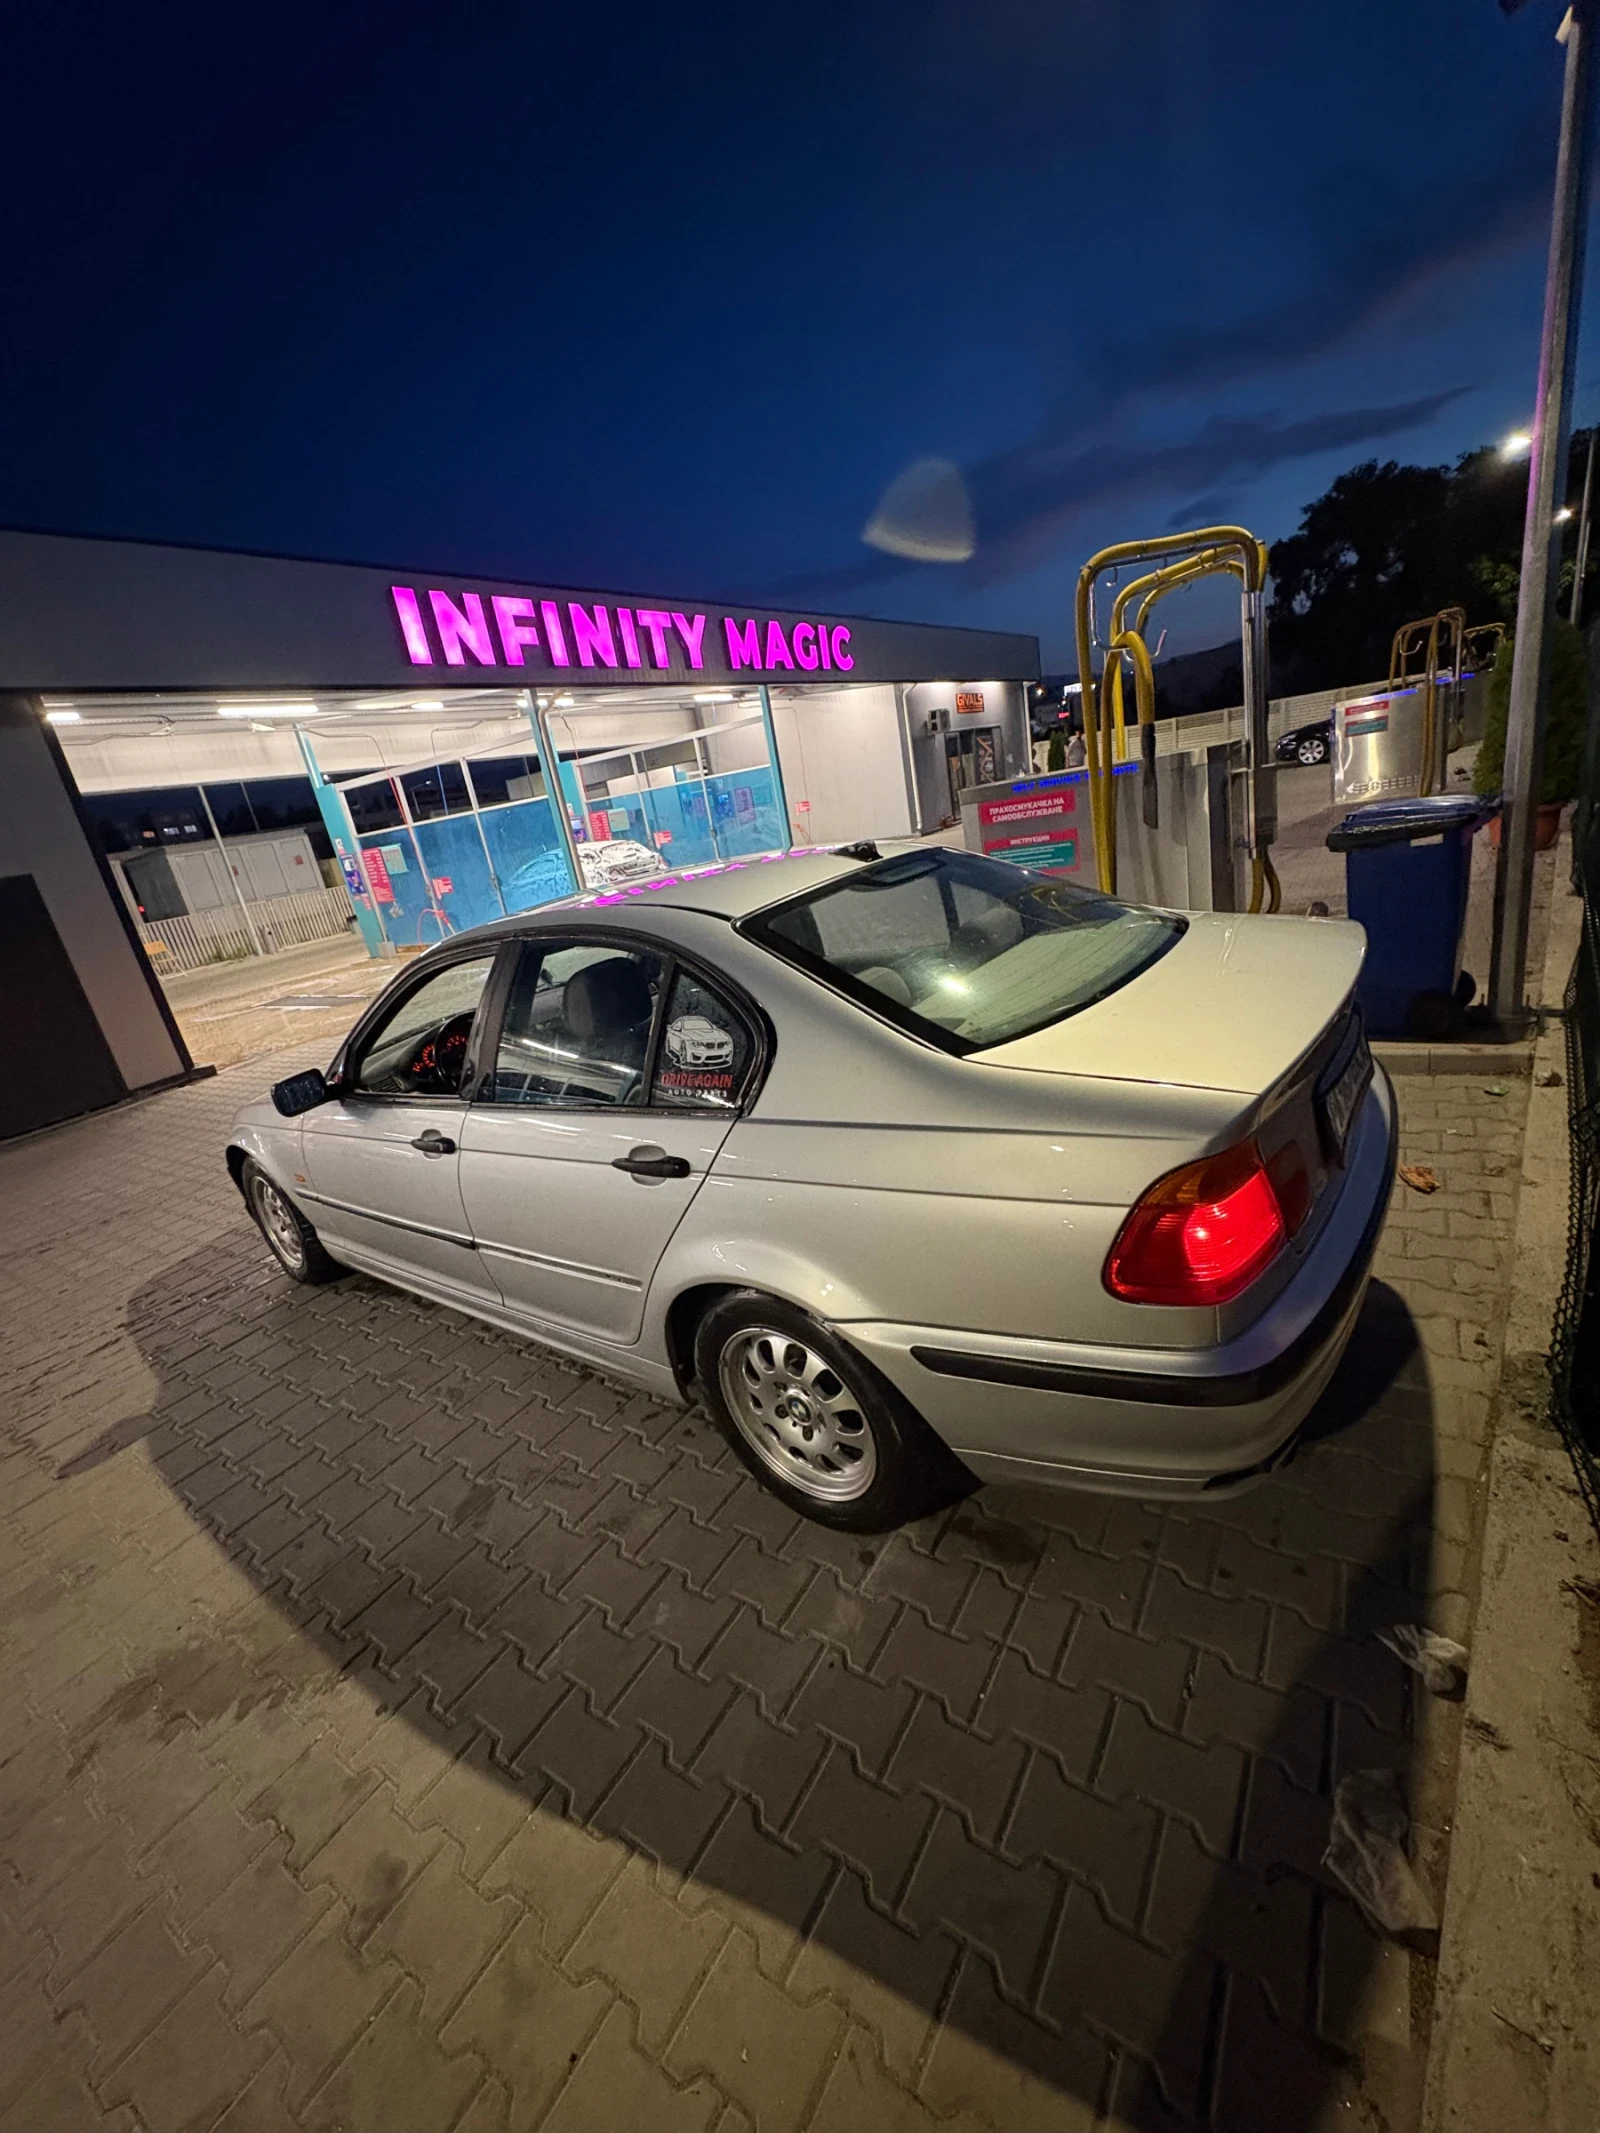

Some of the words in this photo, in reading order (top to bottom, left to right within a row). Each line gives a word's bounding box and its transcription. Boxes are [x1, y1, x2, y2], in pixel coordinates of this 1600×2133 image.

[391, 586, 706, 669] INFINITY
[723, 617, 855, 671] MAGIC
[989, 800, 1053, 815] ПРАХОСМУКАЧКА
[1054, 797, 1065, 805] НА
[992, 806, 1063, 823] САМООБСЛУЖВАНЕ
[668, 1089, 692, 1097] AUTO
